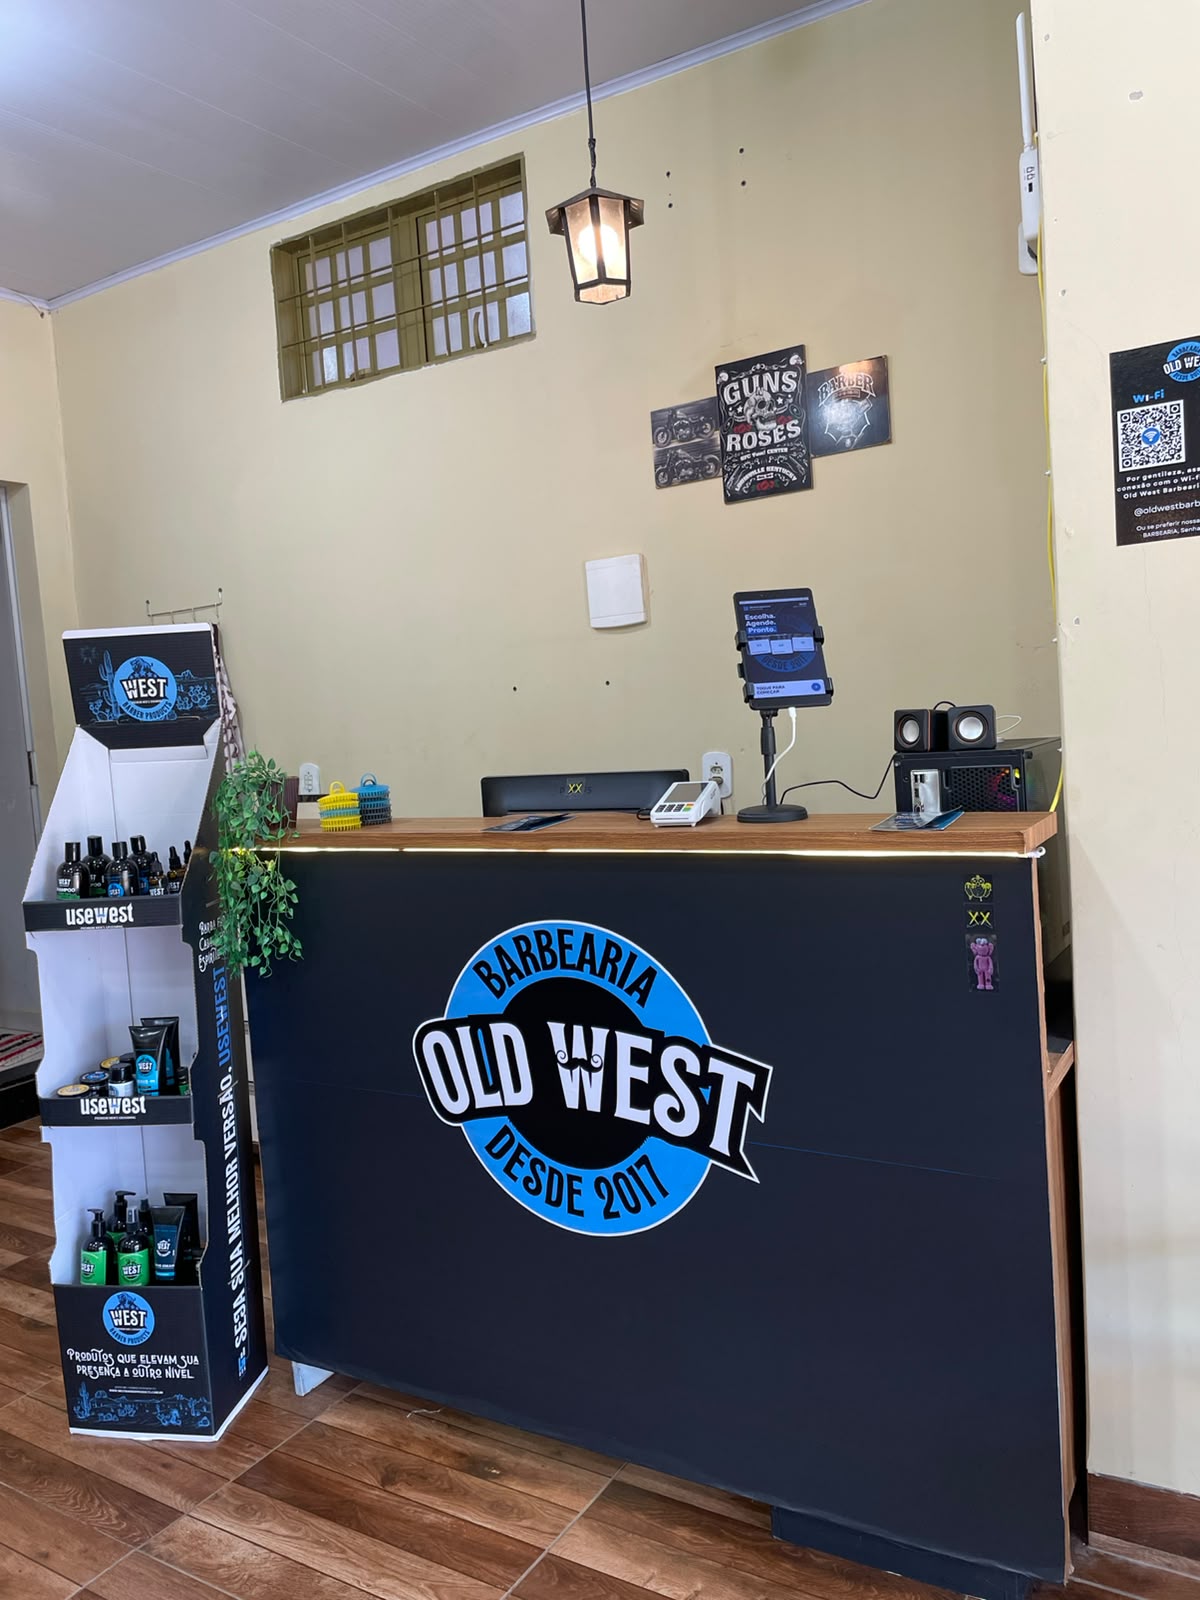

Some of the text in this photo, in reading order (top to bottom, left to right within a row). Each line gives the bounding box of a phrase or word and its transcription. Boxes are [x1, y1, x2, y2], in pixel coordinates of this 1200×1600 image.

[1163, 355, 1200, 375] OLD WE
[723, 371, 798, 405] GUNS
[818, 373, 873, 403] BARBER
[726, 419, 801, 452] ROSES
[1116, 482, 1151, 492] conexão
[1180, 474, 1200, 482] Wi-f
[1142, 470, 1185, 481] gentileza,
[1139, 489, 1160, 497] West
[1162, 482, 1200, 494] Barbeari
[1134, 500, 1200, 517] @oldwestbarb
[1155, 520, 1180, 529] preferir
[122, 678, 167, 700] WEST
[122, 701, 145, 718] BARBER
[66, 902, 134, 925] usewest
[472, 928, 658, 1008] BARBEARIA
[213, 966, 231, 1066] USEWEST
[422, 1021, 756, 1157] OLD WEST
[80, 1095, 146, 1115] usewest
[484, 1124, 670, 1220] DESDE 2017
[226, 1156, 242, 1244] MELHOR
[122, 1265, 141, 1275] WEST
[229, 1241, 244, 1290] SUA
[110, 1310, 146, 1327] WEST
[66, 1348, 199, 1369] PRODUTOS QUE ELEVAM SUA
[76, 1363, 195, 1379] PRESENÇA A OUTRO NÍVEL
